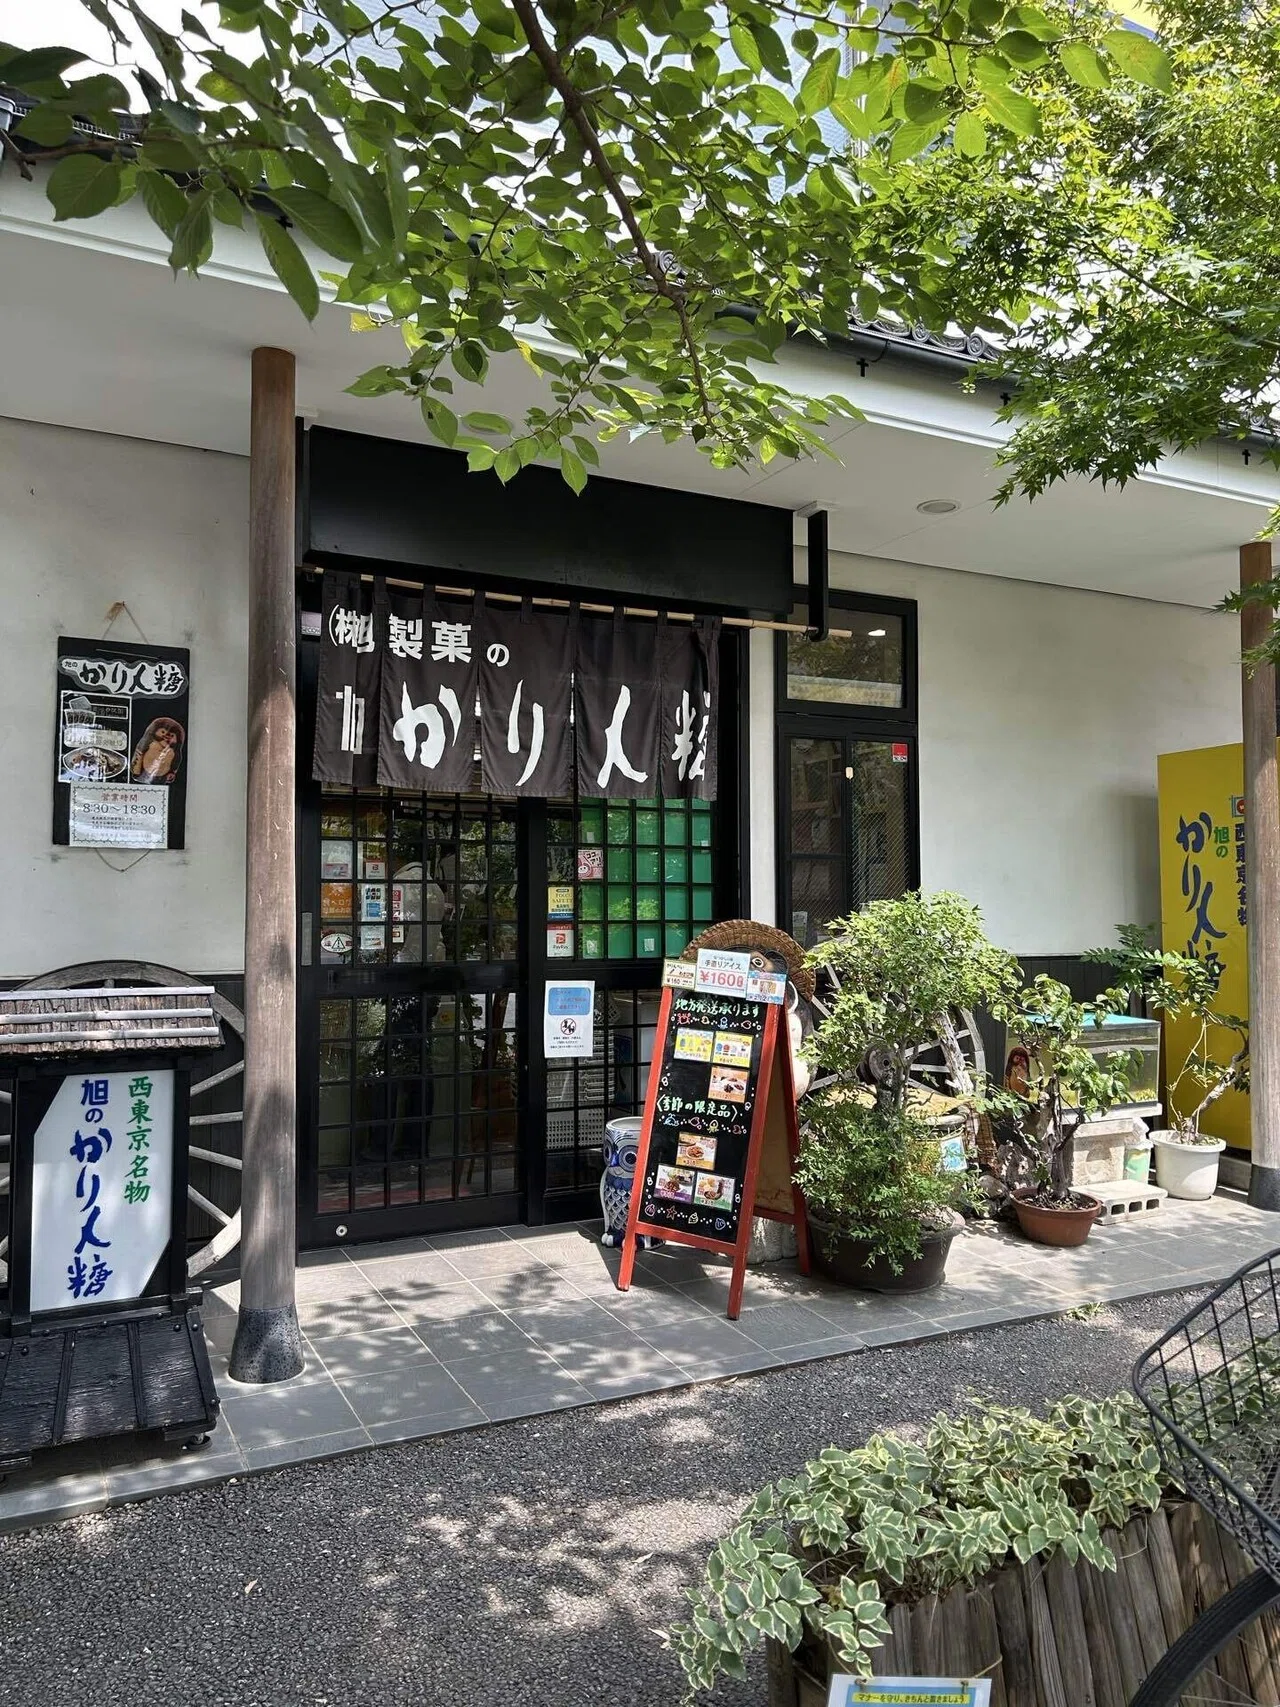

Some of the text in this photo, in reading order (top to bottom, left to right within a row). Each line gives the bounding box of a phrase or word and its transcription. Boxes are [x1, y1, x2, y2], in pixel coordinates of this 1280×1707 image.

[124, 1075, 154, 1204] 西東京名物
